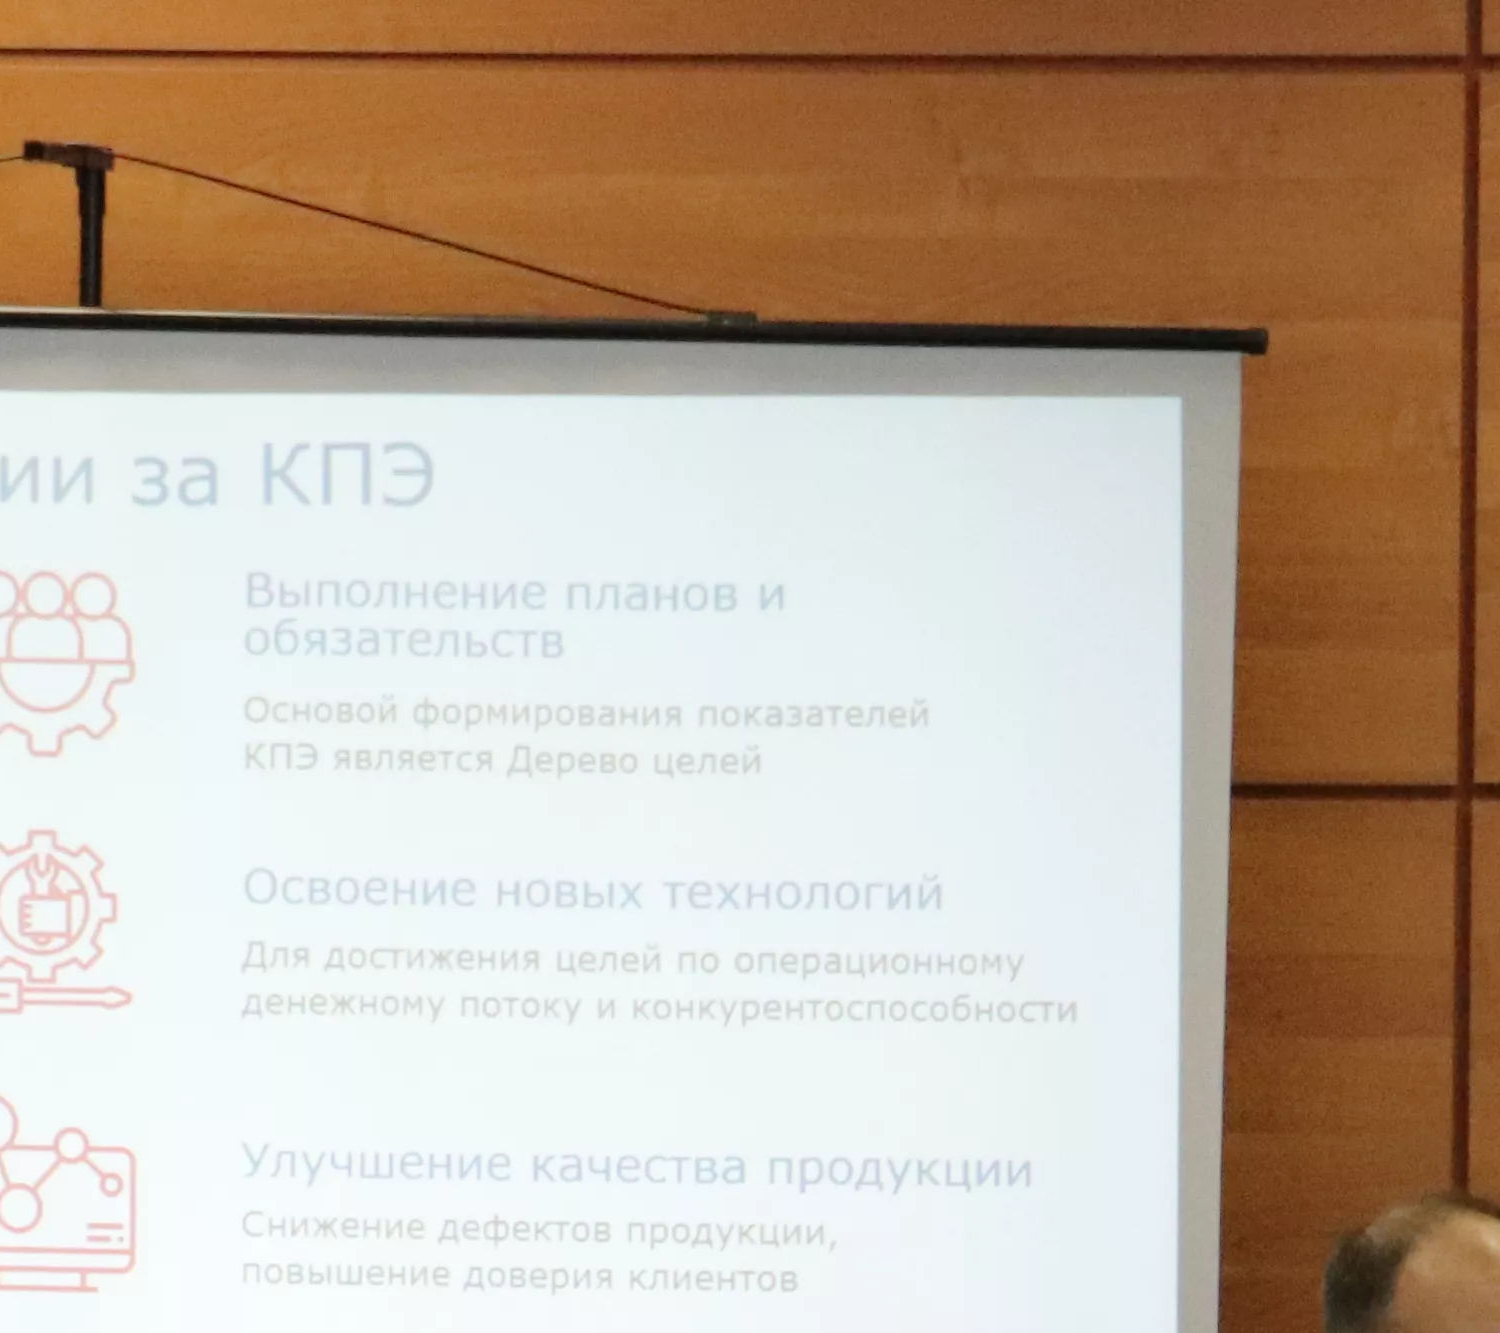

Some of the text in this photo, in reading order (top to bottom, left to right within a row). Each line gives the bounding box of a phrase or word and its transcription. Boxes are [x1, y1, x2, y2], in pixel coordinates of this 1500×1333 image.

[131, 455, 221, 511] за
[262, 440, 437, 510] КПЭ
[245, 572, 787, 614] Выполнение планов и
[244, 618, 566, 660] обязательств
[244, 694, 931, 735] Основой формирования показателей
[245, 743, 764, 782] КПЭ является Дерево целей
[243, 868, 944, 913] Освоение новых технологий
[240, 940, 1026, 984] Для достижения целей по операционному
[240, 993, 1079, 1030] денежному потоку и конкурентоспособности
[241, 1142, 1034, 1197] Улучшение качества продукции
[241, 1210, 839, 1254] Снижение дефектов продукции,
[242, 1262, 801, 1297] повышение доверия клиентов
